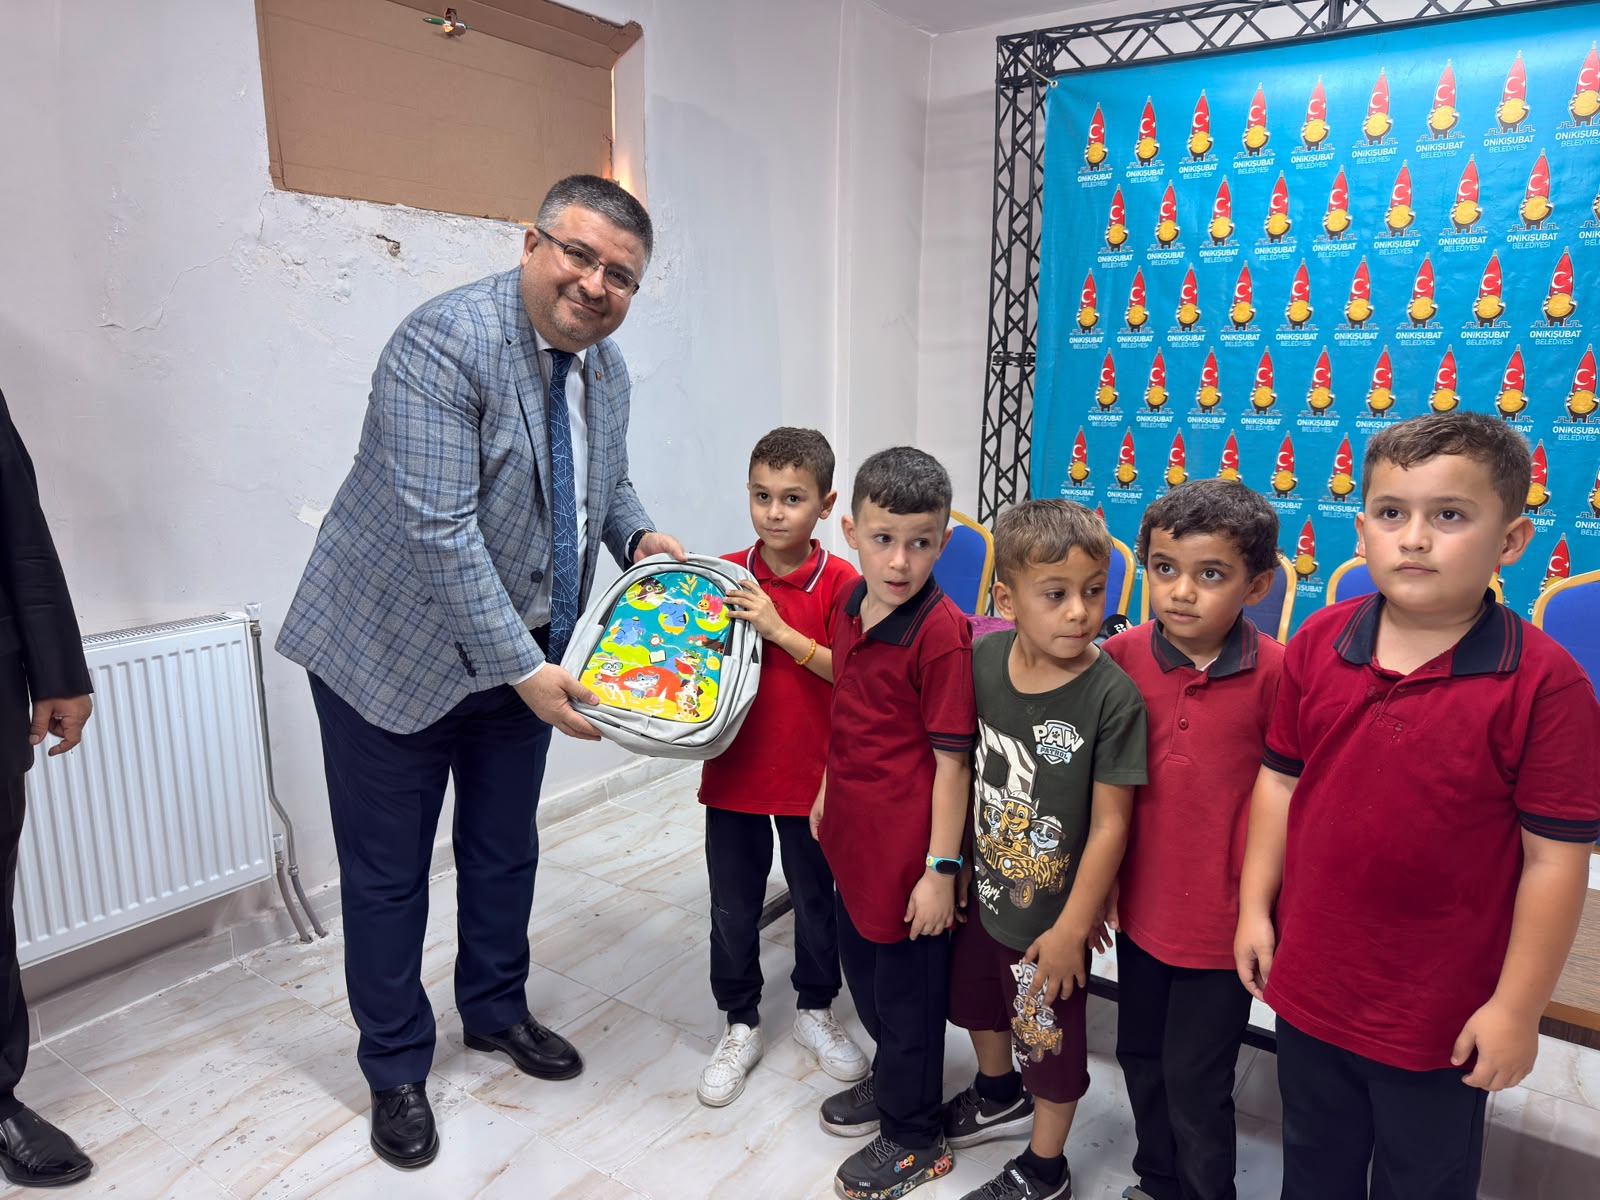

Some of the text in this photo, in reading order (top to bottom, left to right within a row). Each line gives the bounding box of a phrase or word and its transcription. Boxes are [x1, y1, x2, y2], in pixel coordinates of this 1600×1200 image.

[1032, 724, 1084, 752] PAW
[1040, 748, 1068, 760] PATROL
[1010, 1170, 1026, 1184] NIKE
